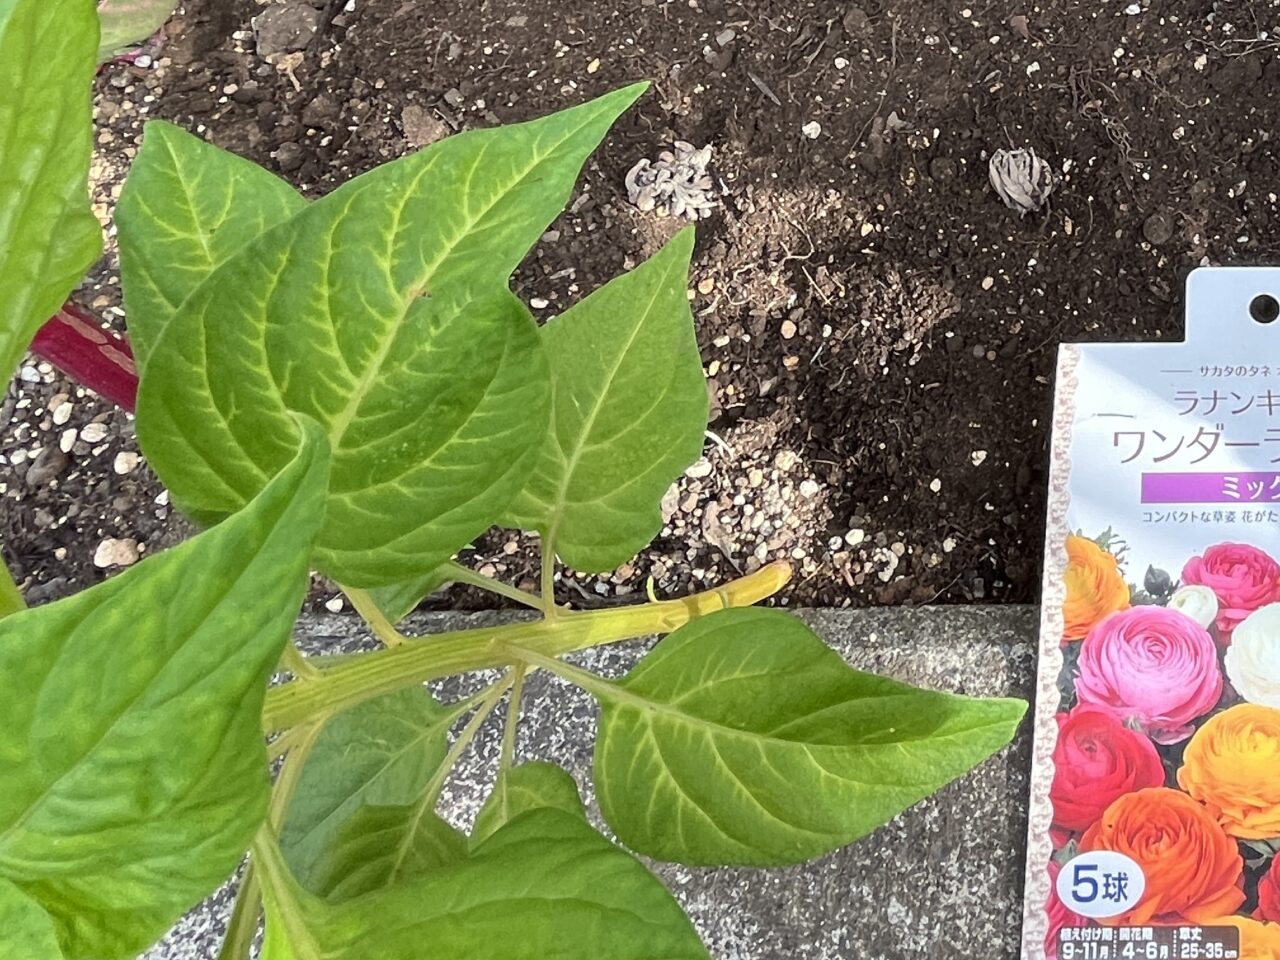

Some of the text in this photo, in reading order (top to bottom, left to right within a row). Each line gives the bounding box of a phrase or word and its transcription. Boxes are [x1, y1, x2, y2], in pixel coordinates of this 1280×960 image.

[1199, 365, 1271, 378] サカタのタネ
[1143, 510, 1236, 523] コンパクトな草姿
[1071, 865, 1129, 903] 5球
[1119, 928, 1153, 940] 開花期
